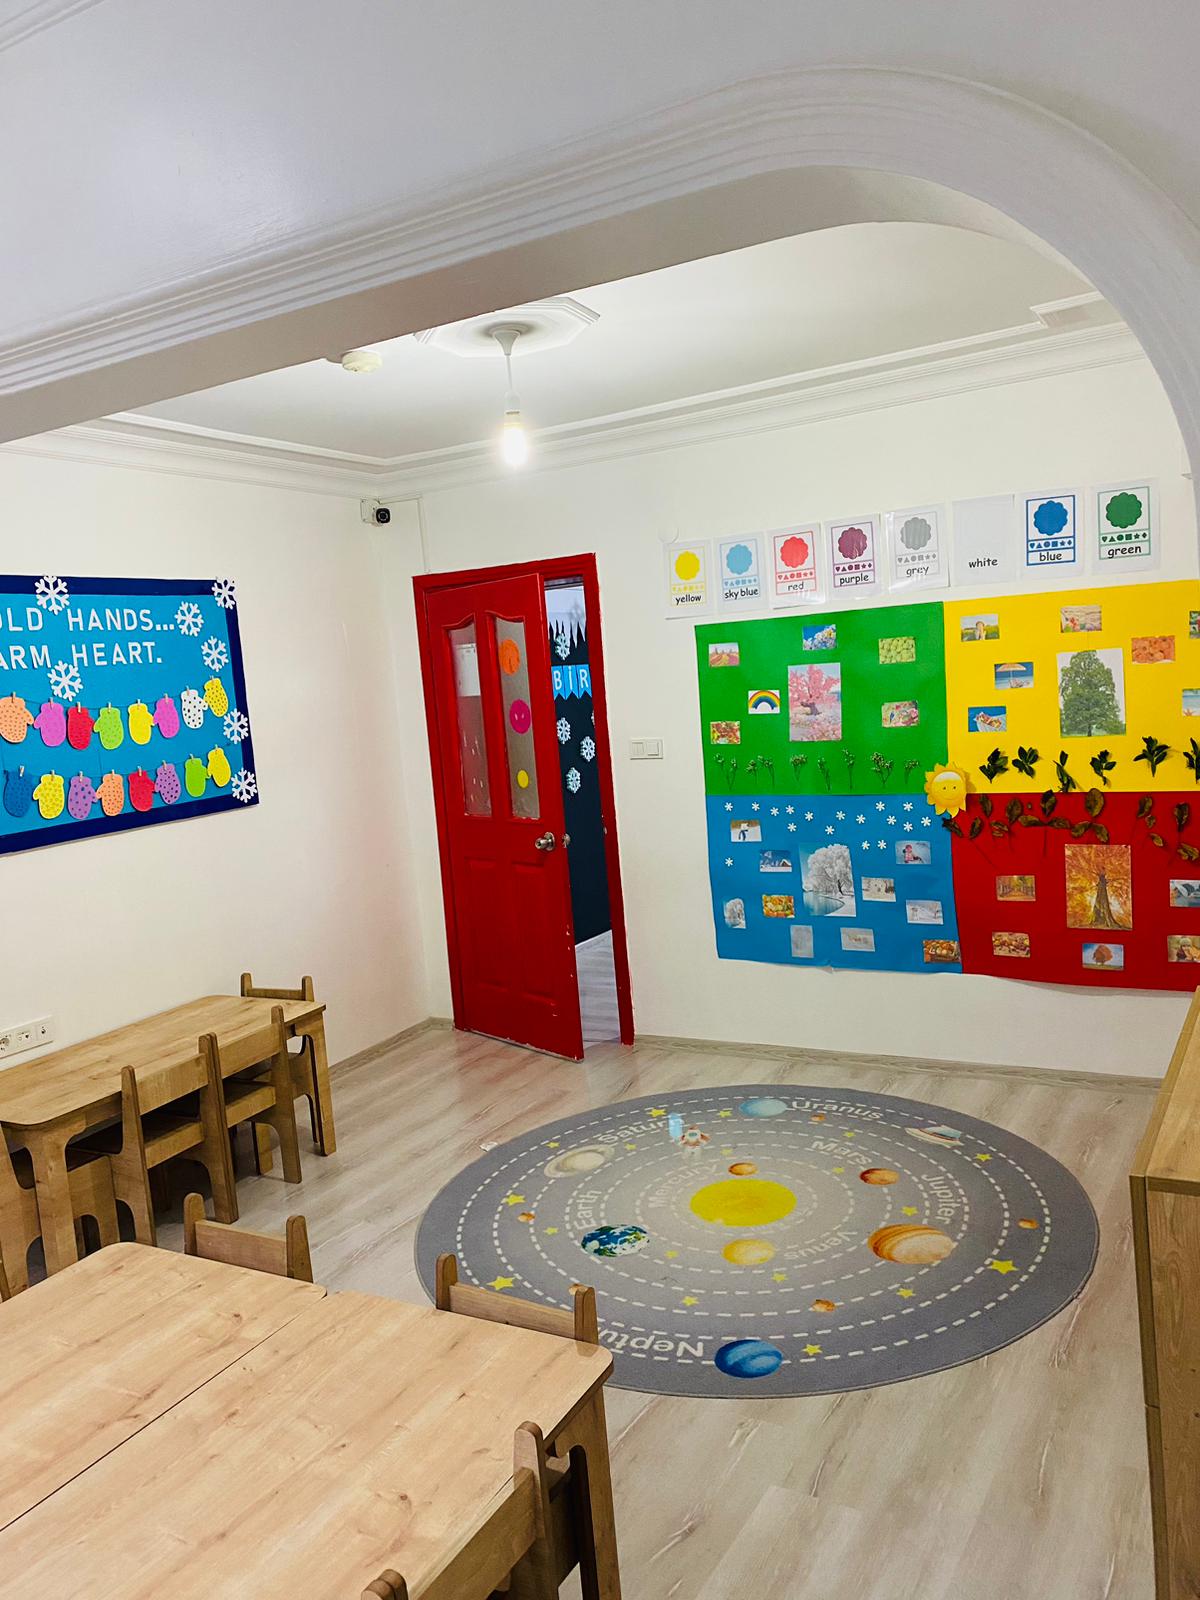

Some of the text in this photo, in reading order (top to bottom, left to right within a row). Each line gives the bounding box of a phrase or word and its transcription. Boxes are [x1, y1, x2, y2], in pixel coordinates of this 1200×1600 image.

[1039, 552, 1063, 562] blue
[1107, 544, 1142, 559] green
[906, 566, 929, 577] grey
[968, 558, 998, 568] white
[787, 581, 804, 592] red
[839, 573, 869, 586] purple
[675, 594, 702, 606] yellow
[724, 587, 759, 601] sky blue
[0, 607, 175, 632] LD HANDS...
[72, 641, 163, 668] HEART.
[791, 1100, 884, 1119] Uranus
[598, 1120, 667, 1143] Satur
[811, 1141, 872, 1165] Mars
[648, 1164, 717, 1208] Mercury
[921, 1174, 961, 1224] Jupiter
[573, 1190, 602, 1230] Earth
[784, 1231, 858, 1261] Venus
[598, 1328, 704, 1358] Neptu
